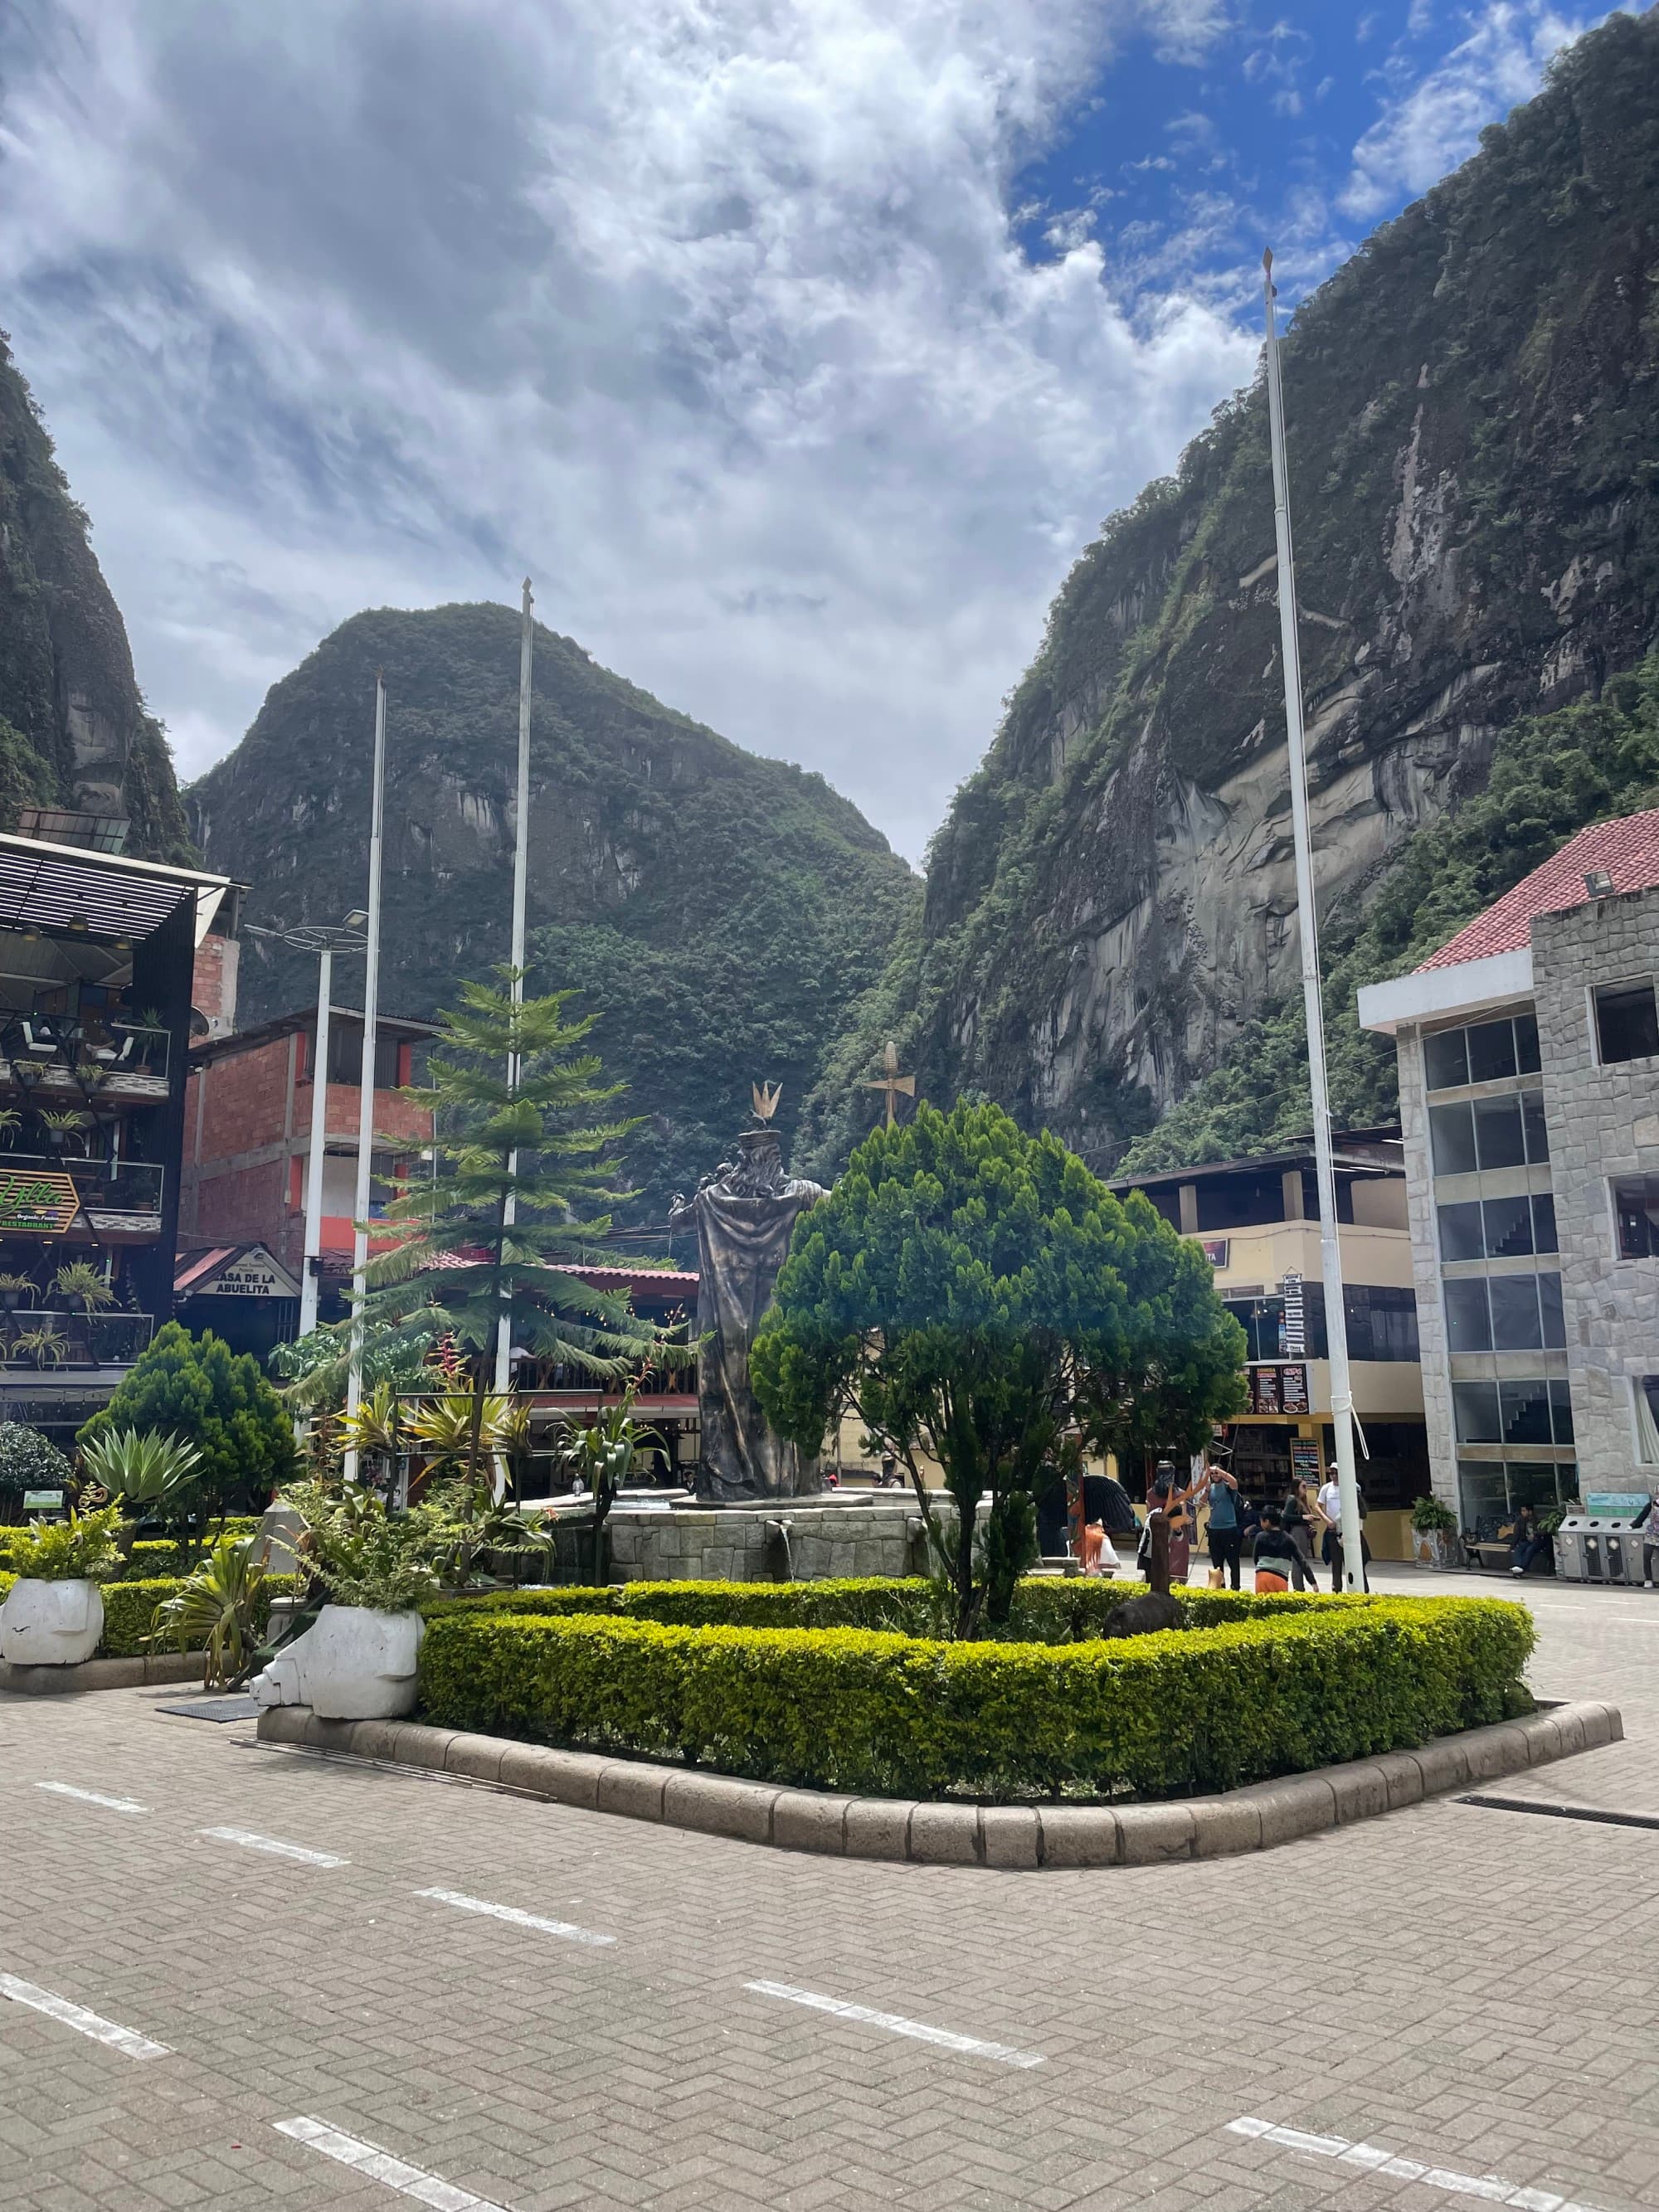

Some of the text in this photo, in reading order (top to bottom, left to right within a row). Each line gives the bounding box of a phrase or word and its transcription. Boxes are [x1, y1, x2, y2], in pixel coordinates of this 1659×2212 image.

[245, 1273, 259, 1283] DE
[262, 1274, 275, 1284] LA
[216, 1283, 270, 1294] ABUELITA
